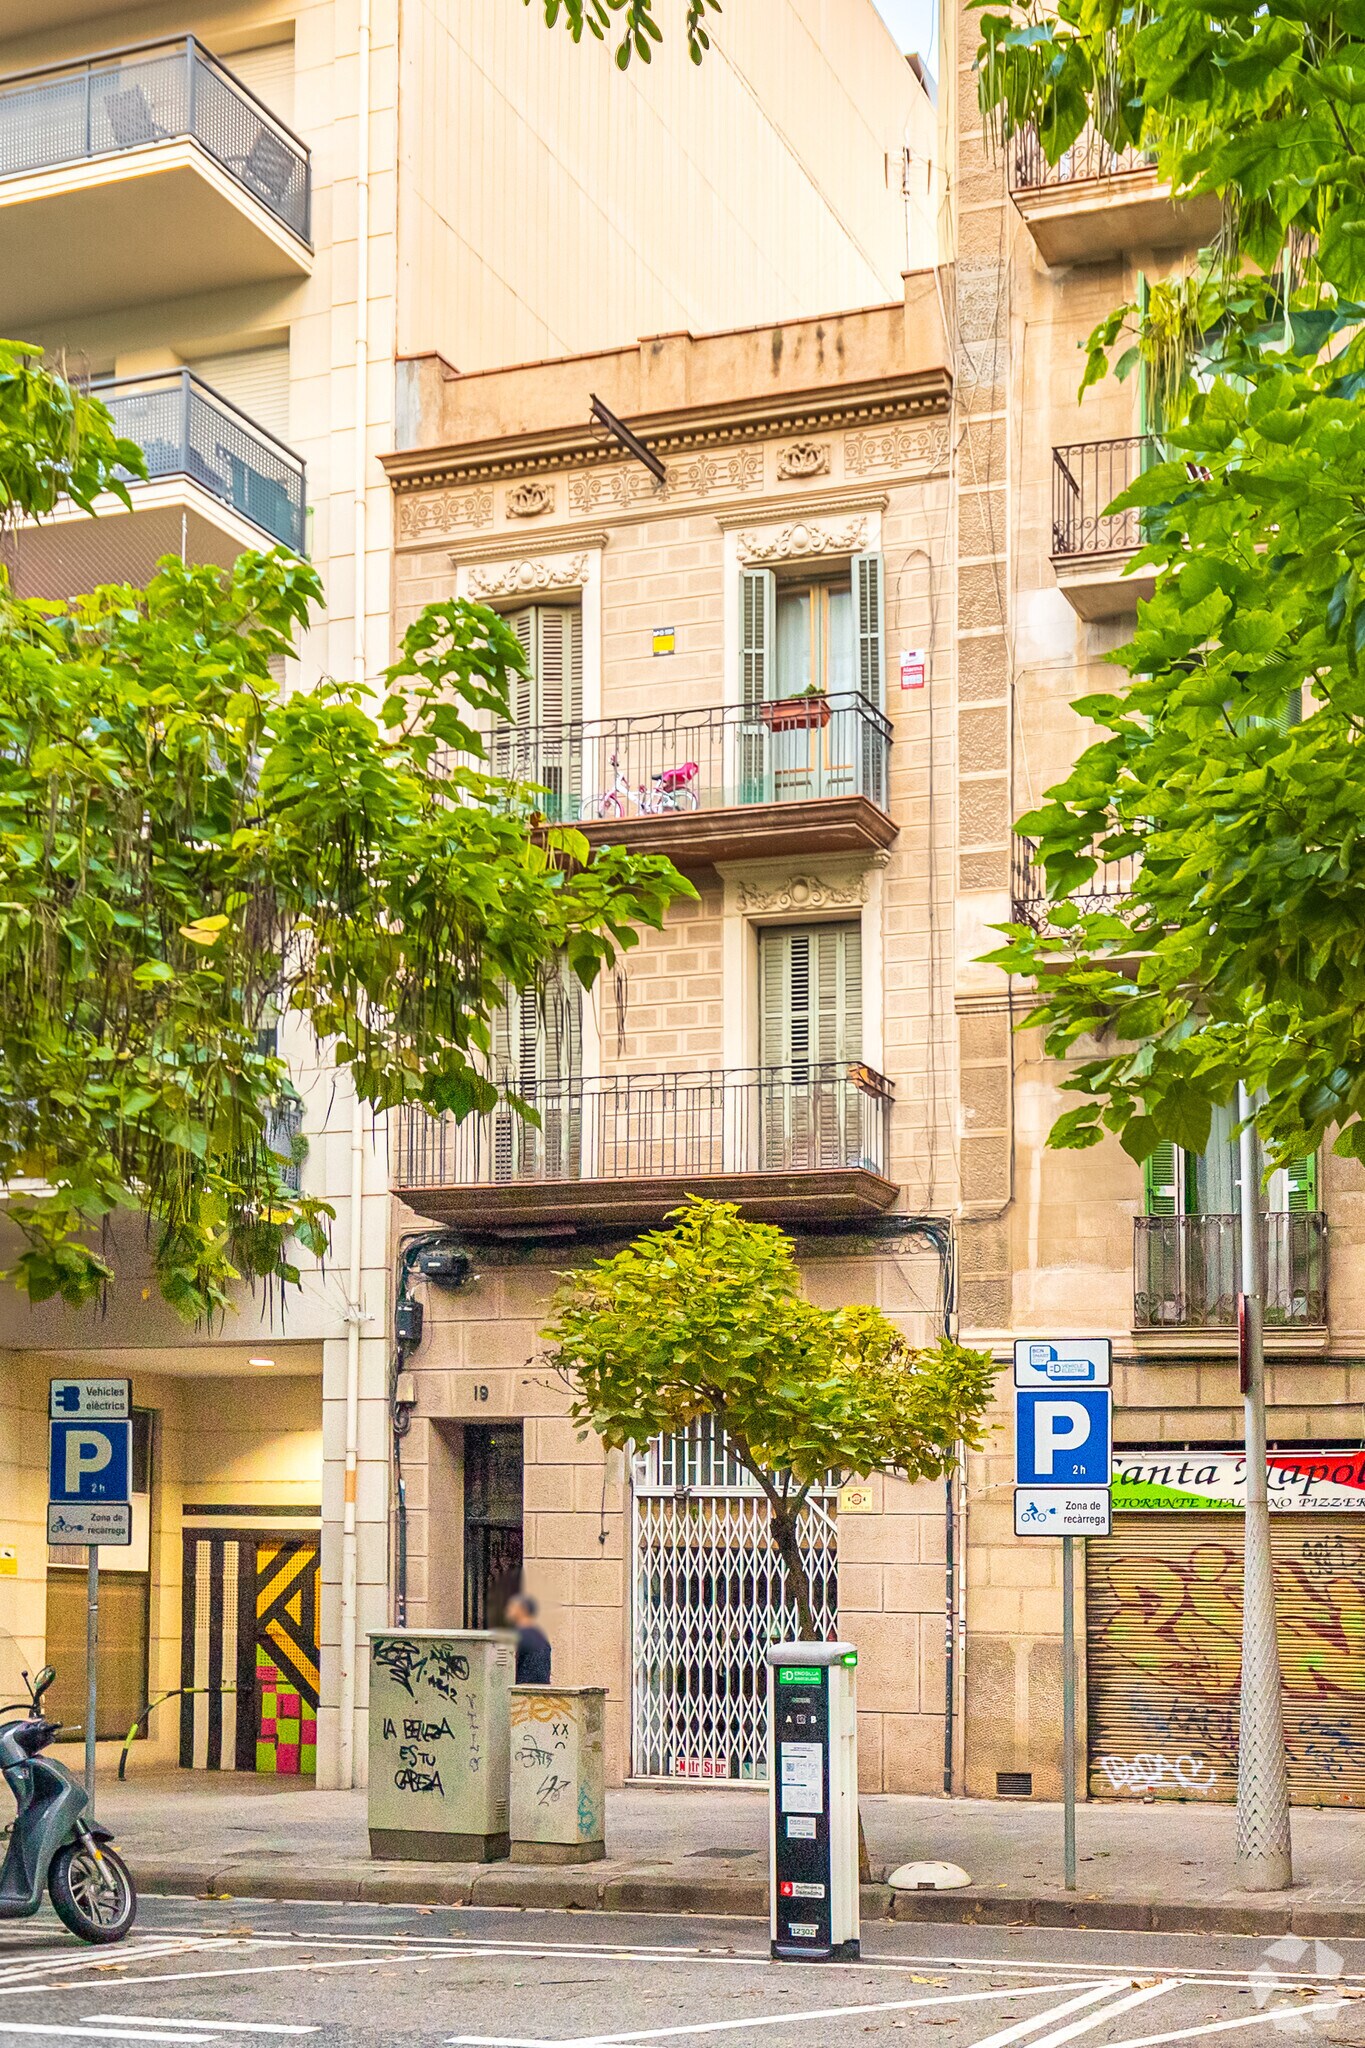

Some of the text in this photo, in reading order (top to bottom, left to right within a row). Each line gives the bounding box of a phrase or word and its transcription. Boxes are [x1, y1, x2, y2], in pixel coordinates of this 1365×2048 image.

[86, 1387, 124, 1396] Vehicles
[474, 1385, 488, 1400] 19
[1034, 1401, 1090, 1474] P
[65, 1430, 112, 1493] P
[1066, 1501, 1101, 1510] Zona de
[1206, 1497, 1292, 1509] ITALNO
[113, 1513, 123, 1521] de
[1064, 1514, 1105, 1526] recàrrega
[785, 1715, 817, 1723] A B
[400, 1744, 436, 1768] ES TU
[792, 1928, 815, 1936] 12302
